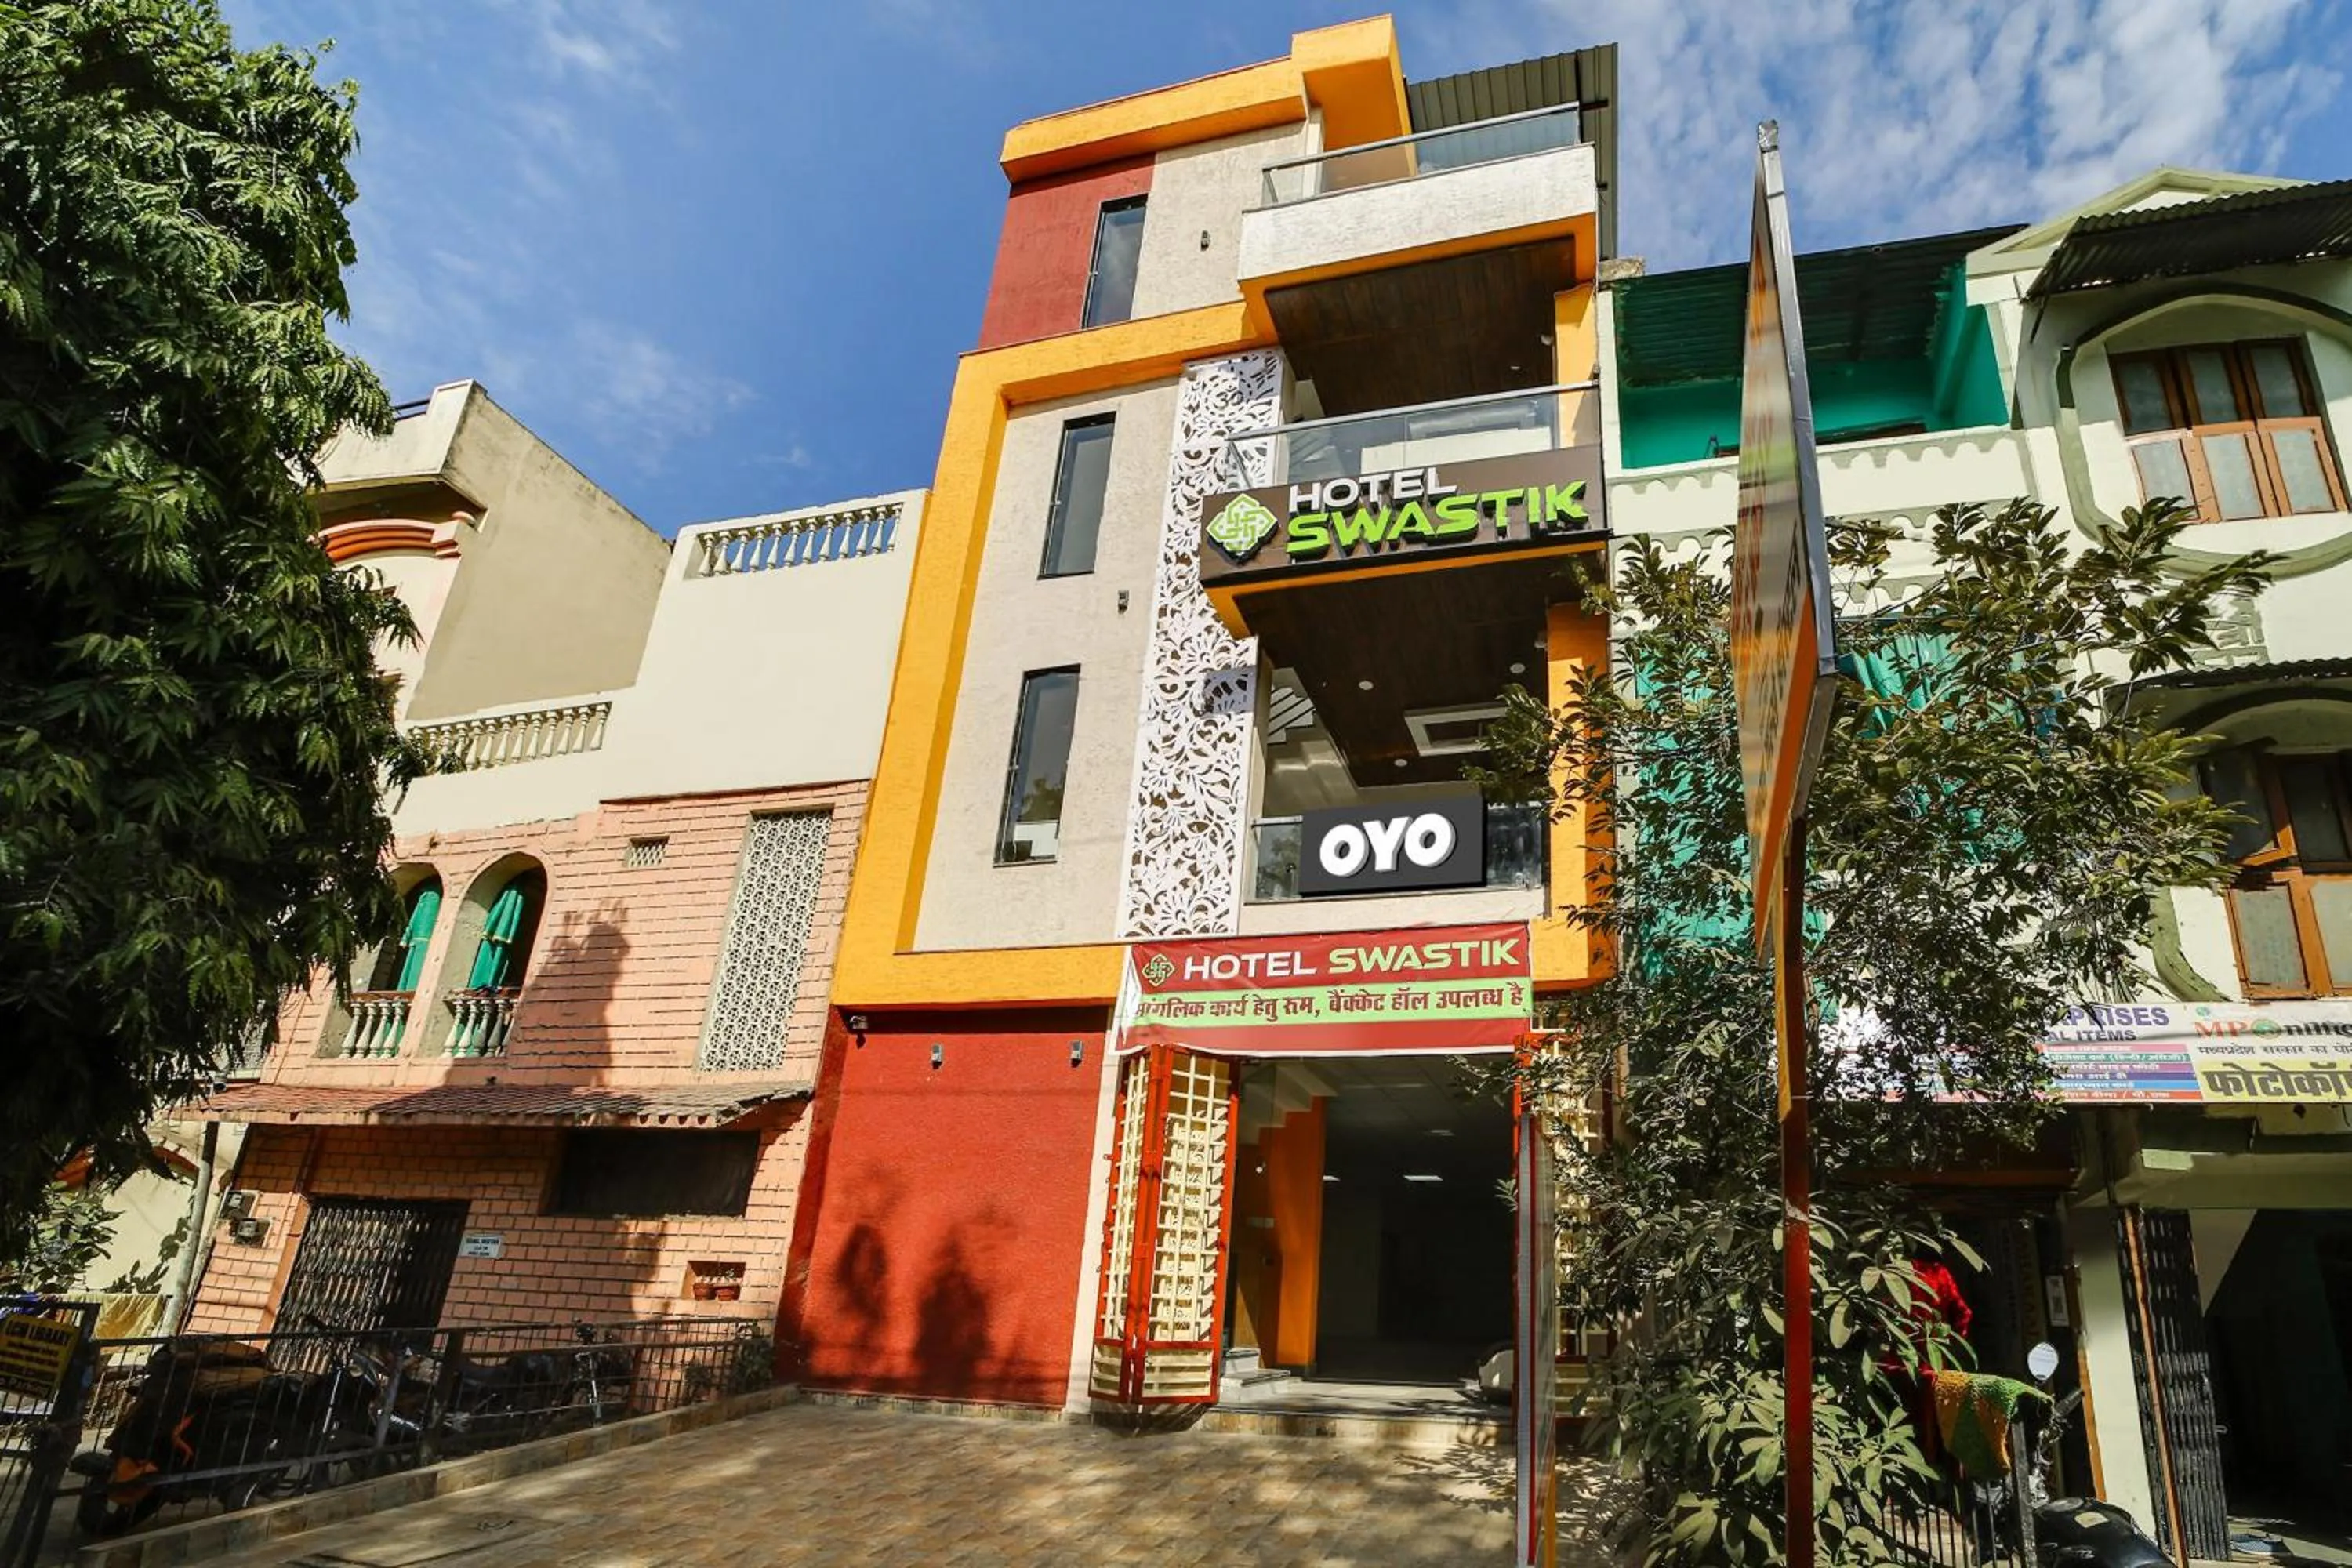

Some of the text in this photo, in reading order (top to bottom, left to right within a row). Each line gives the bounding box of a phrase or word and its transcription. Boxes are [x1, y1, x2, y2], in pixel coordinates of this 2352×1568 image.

[1289, 466, 1457, 513] HOTEL
[1287, 480, 1589, 553] SWASTIK
[1319, 813, 1456, 877] OYO
[1183, 938, 1520, 980] HOTEL SWASTIK
[1210, 993, 1249, 1017] कार्य
[1253, 993, 1279, 1022] हेतु
[1391, 987, 1430, 1011] हॉल
[1436, 988, 1504, 1009] उपलब्ध
[1506, 982, 1525, 1006] है
[2078, 1029, 2137, 1042] ITEMS
[2308, 1044, 2328, 1054] का
[2201, 1062, 2352, 1097] फोटोकॉ
